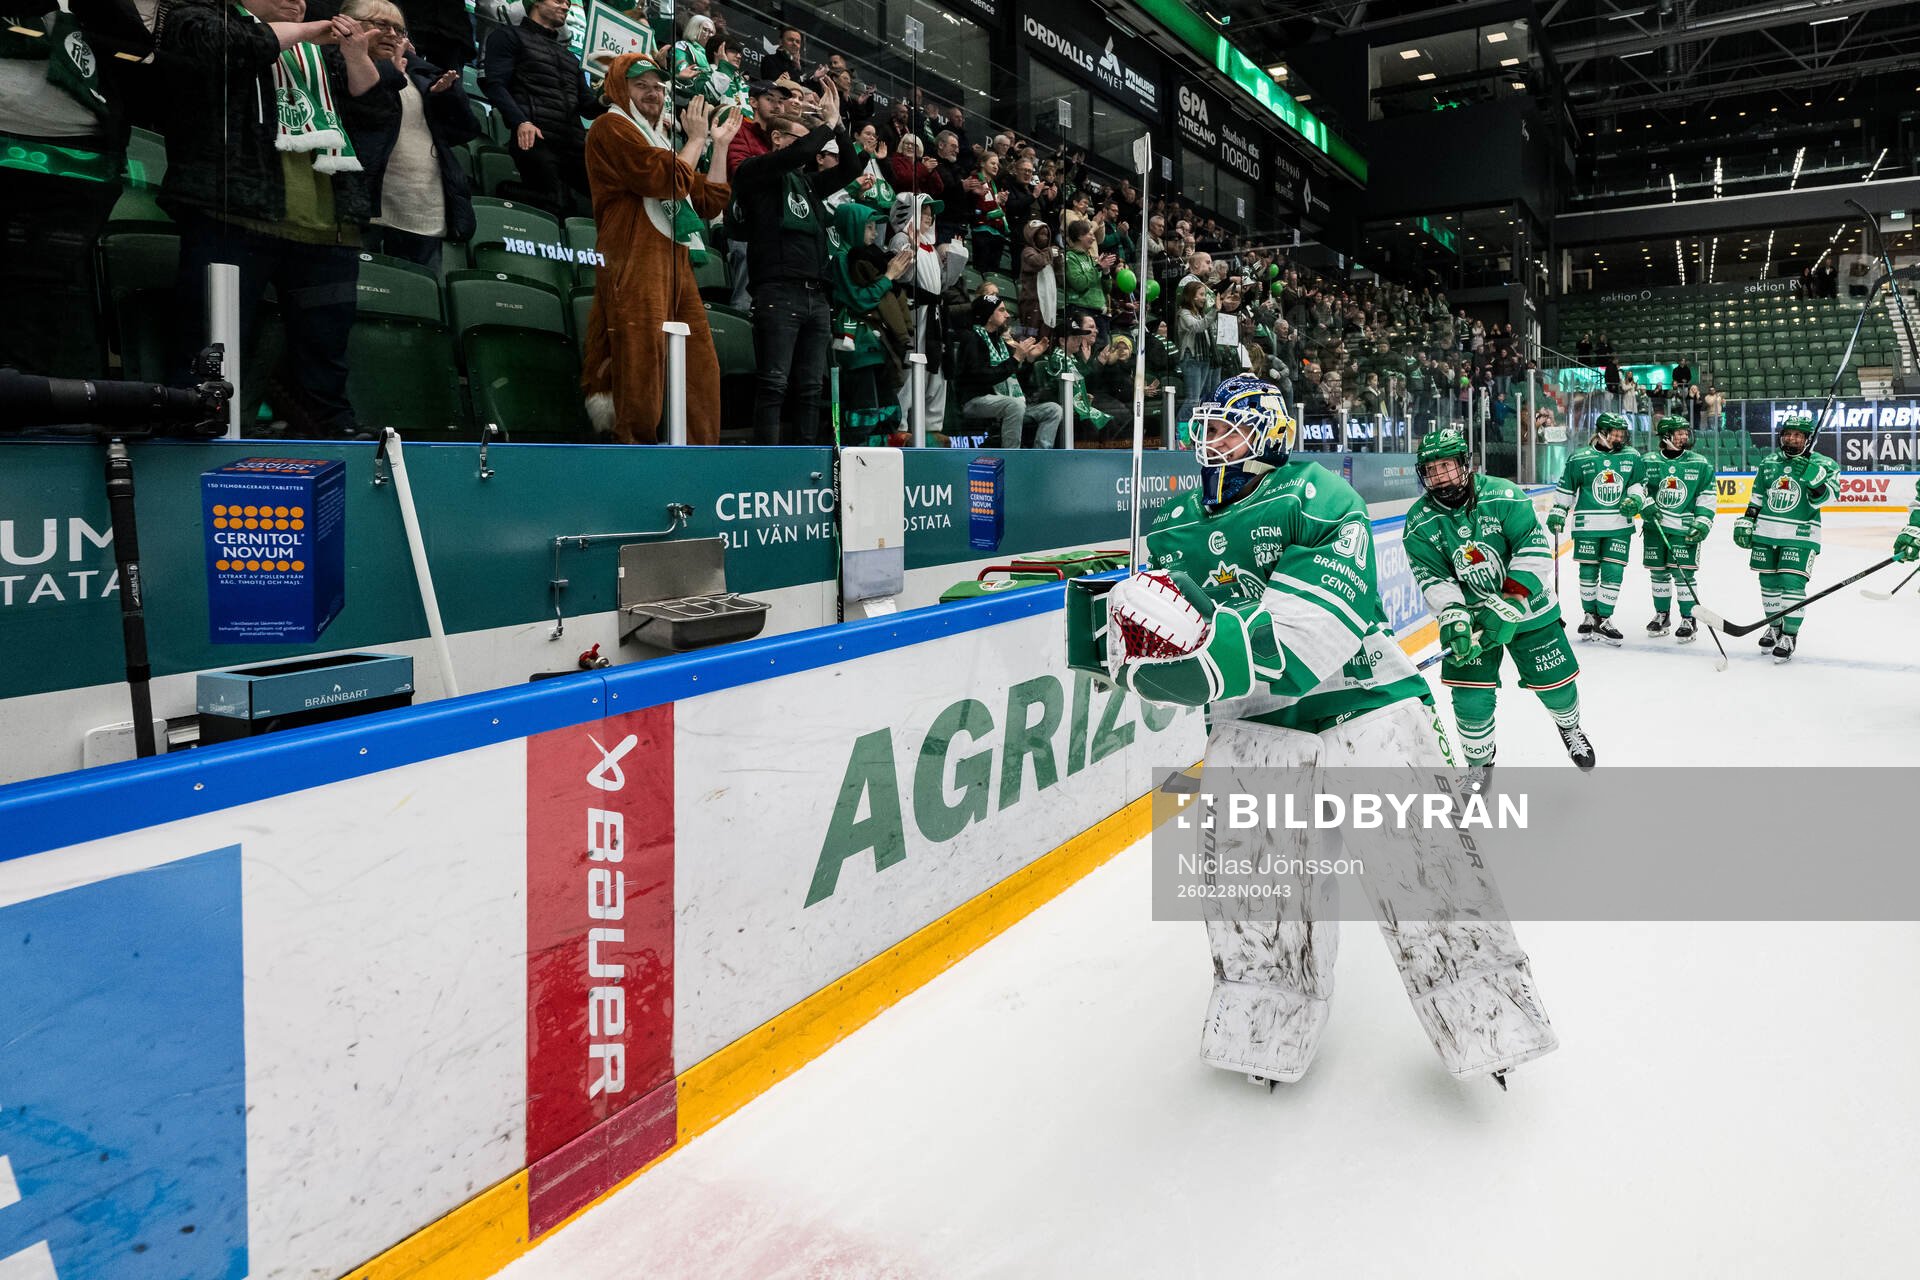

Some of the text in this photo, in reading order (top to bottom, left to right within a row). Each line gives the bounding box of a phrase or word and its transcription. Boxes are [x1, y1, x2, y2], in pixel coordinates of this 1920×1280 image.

[1097, 66, 1123, 90] NAVET
[1179, 86, 1208, 125] GPA
[1600, 291, 1638, 303] sektion
[1744, 282, 1785, 294] sektion
[1846, 433, 1920, 461] SKÅN
[1116, 475, 1168, 495] CENITOL
[715, 484, 952, 522] CERNITO VUM
[1117, 500, 1129, 511] BLI
[214, 532, 302, 545] CERNITOL
[718, 530, 748, 550] BLI
[756, 523, 798, 546] VÄN
[1250, 526, 1283, 541] CATENA
[223, 546, 294, 559] NOVUM
[1332, 520, 1369, 570] 30
[1312, 553, 1368, 595] BRÄNNBORN
[1320, 574, 1356, 603] CENTER
[1535, 648, 1562, 664] SALTA
[305, 688, 369, 708] BRÄNNBART
[803, 673, 1206, 909] AGRIZ
